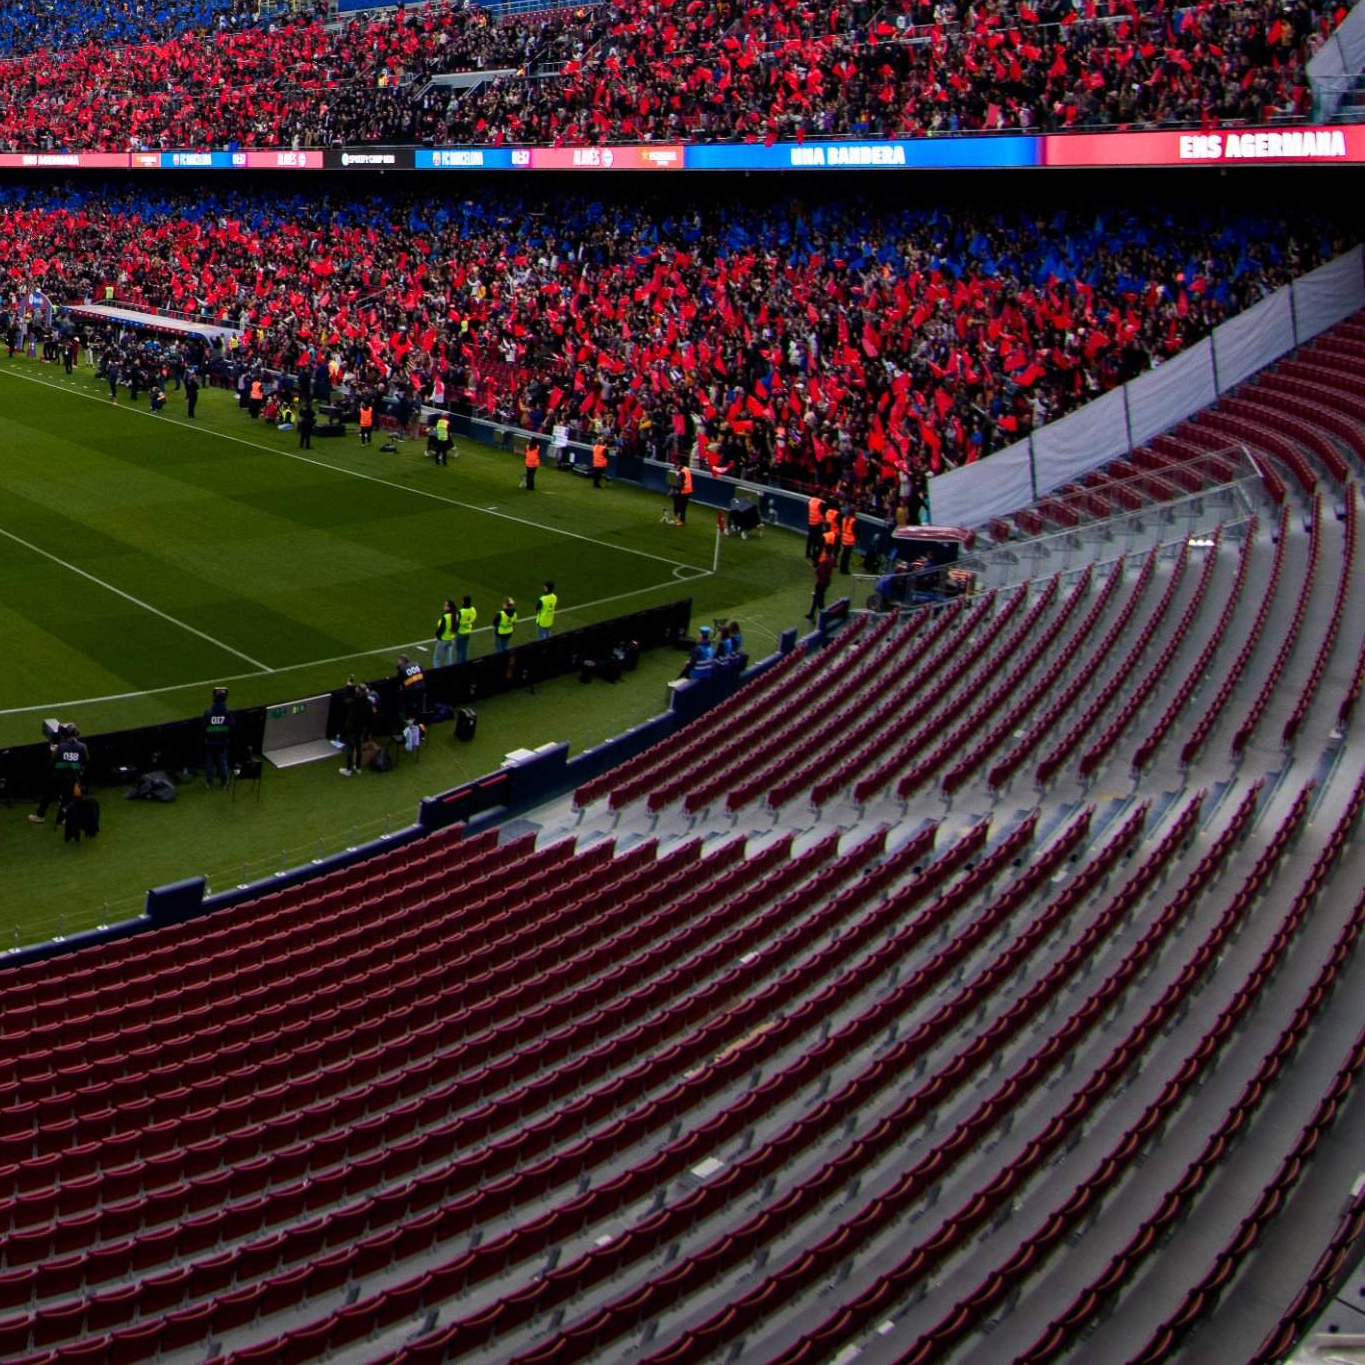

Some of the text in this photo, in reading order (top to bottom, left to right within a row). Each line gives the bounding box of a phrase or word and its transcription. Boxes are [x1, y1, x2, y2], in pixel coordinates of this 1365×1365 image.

[791, 146, 906, 165] UNA BANDERA
[1180, 131, 1346, 159] ENS AGERMANA
